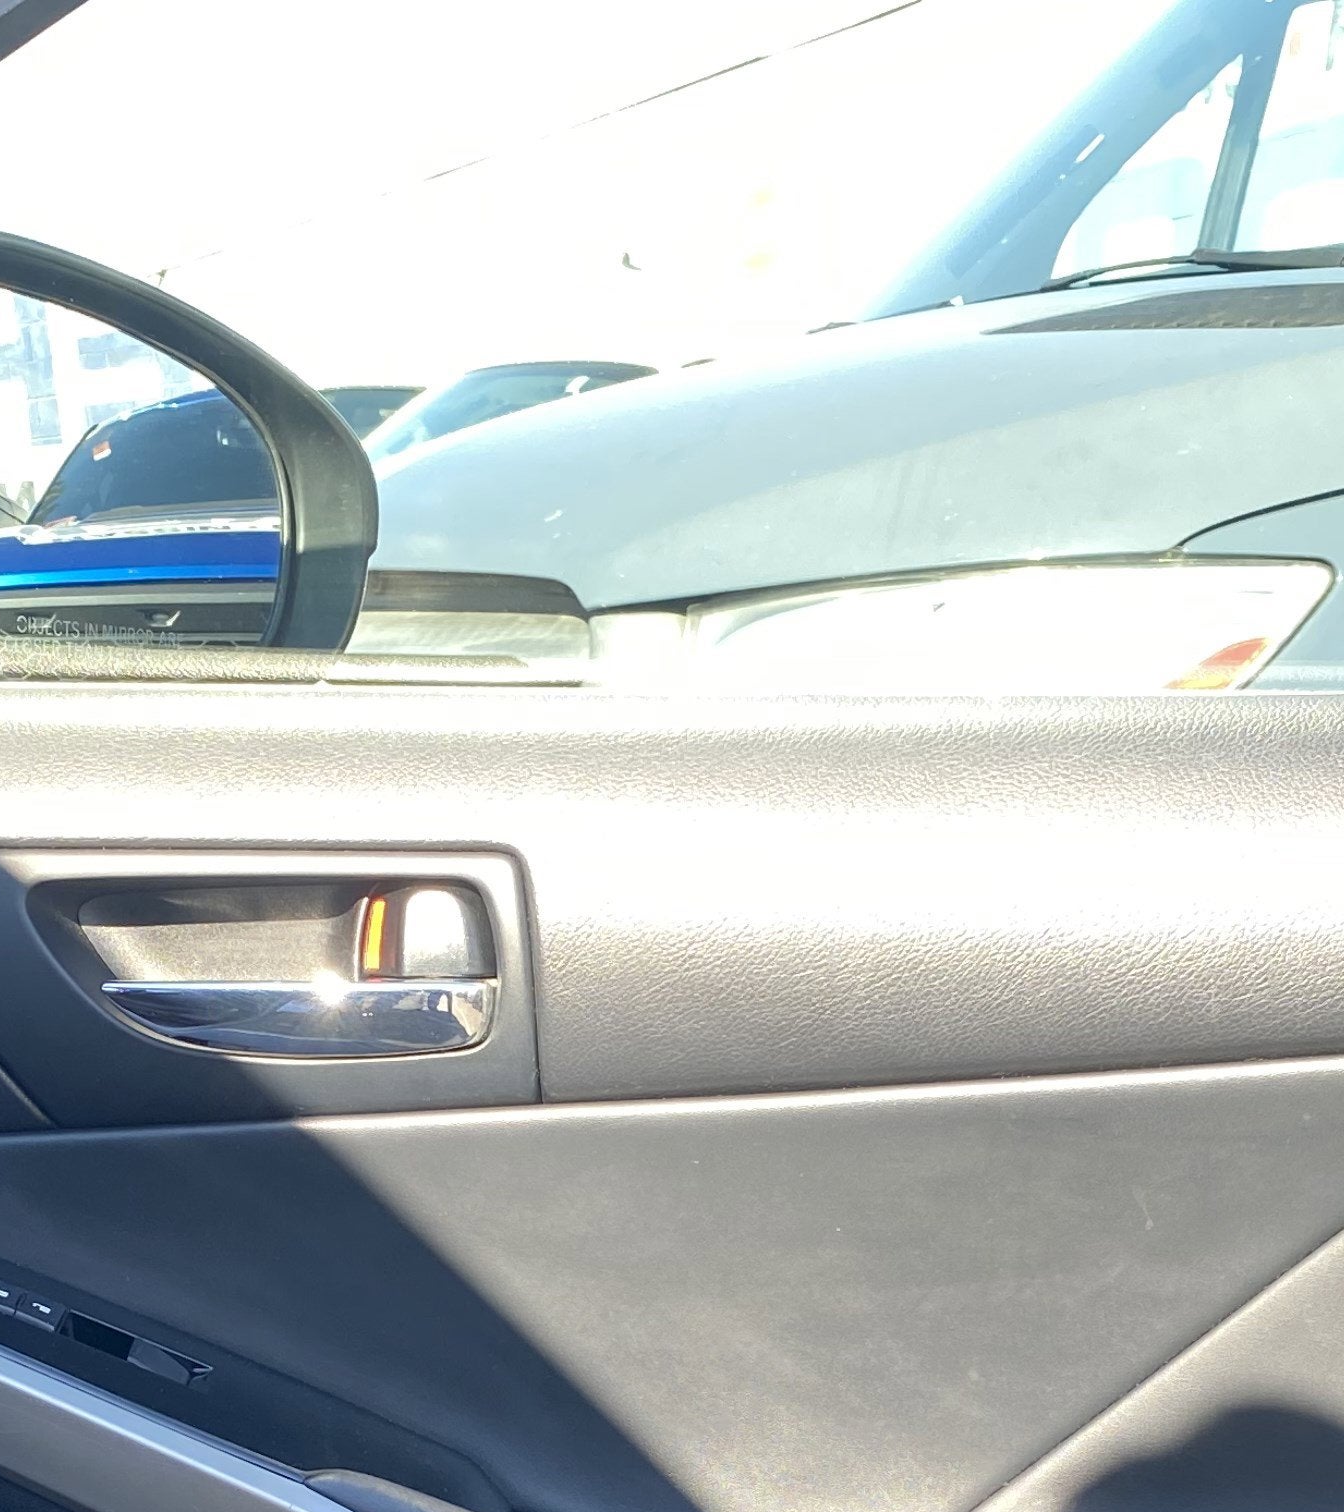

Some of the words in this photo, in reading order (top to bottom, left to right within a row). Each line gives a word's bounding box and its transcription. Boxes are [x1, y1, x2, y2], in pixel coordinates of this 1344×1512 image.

[16, 614, 80, 639] OBJECTS
[84, 621, 100, 641] IN
[102, 624, 154, 646] MIRROR
